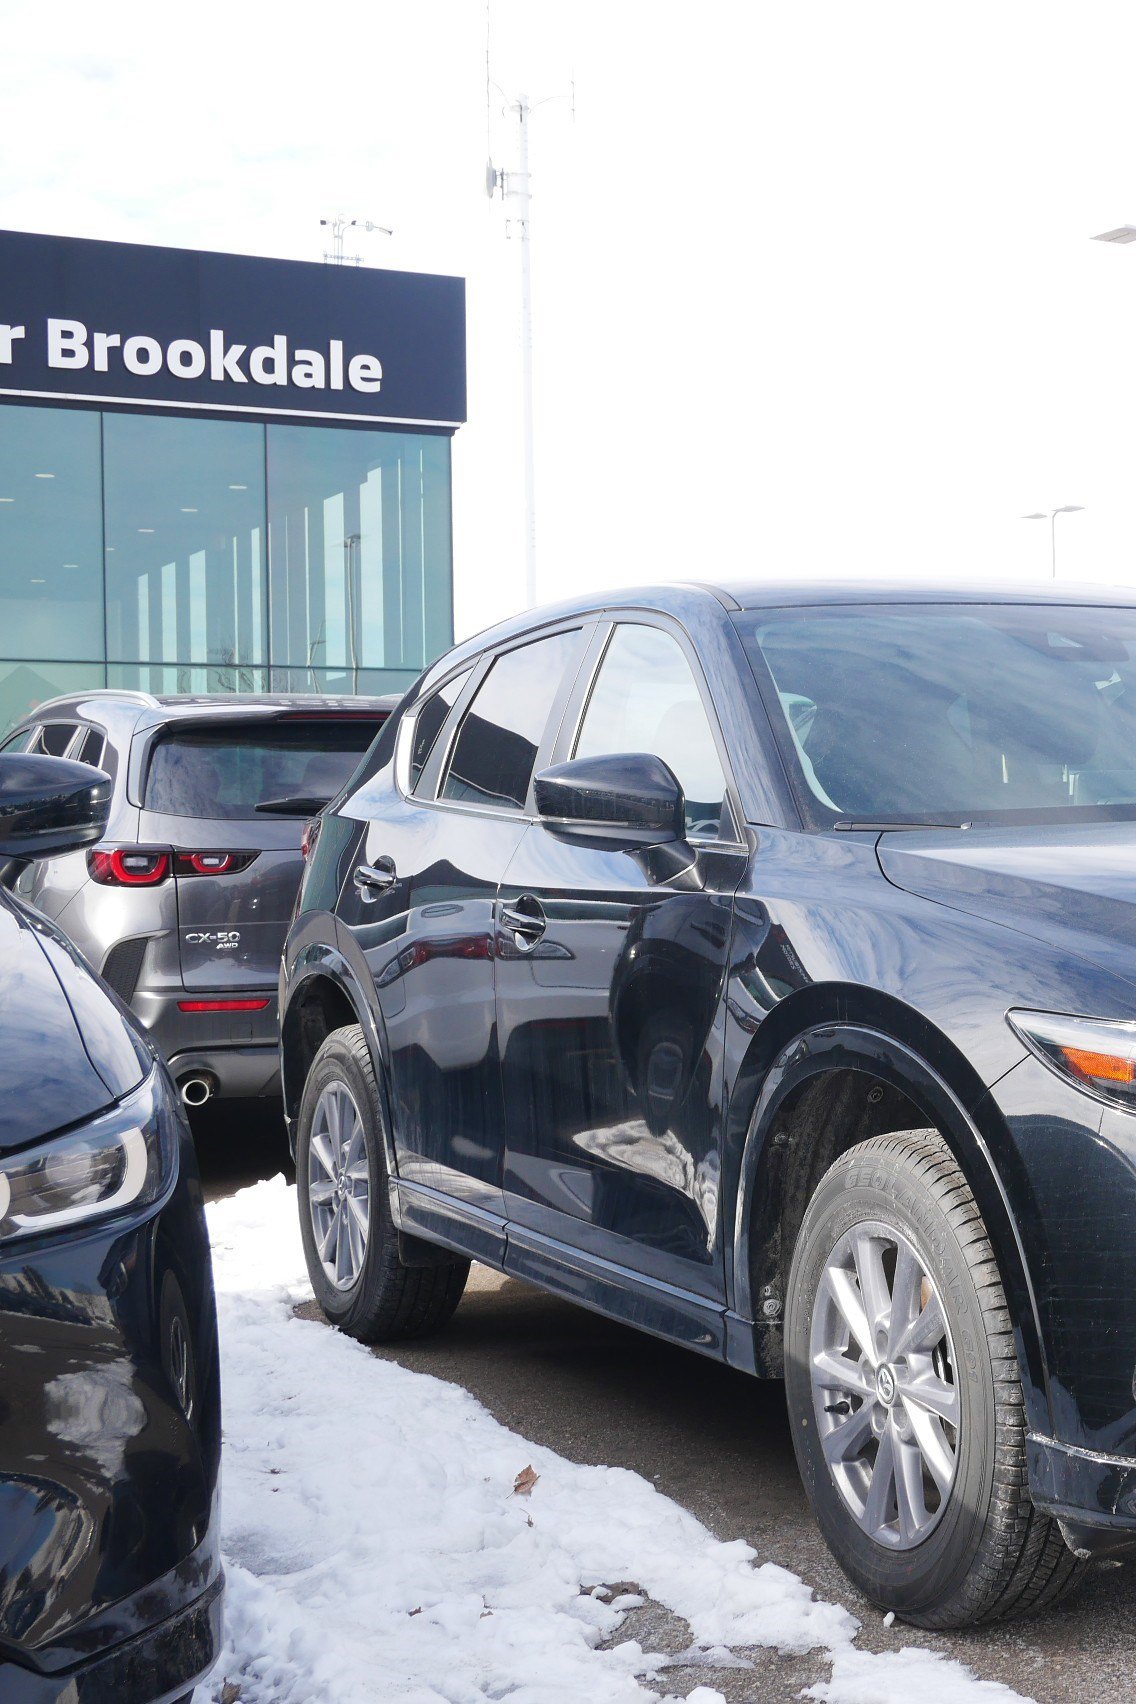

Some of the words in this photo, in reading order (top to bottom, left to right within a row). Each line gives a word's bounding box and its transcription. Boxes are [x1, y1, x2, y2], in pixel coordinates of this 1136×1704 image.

[47, 318, 383, 393] Brookdale
[185, 931, 241, 943] CX-50
[216, 942, 239, 950] AWD
